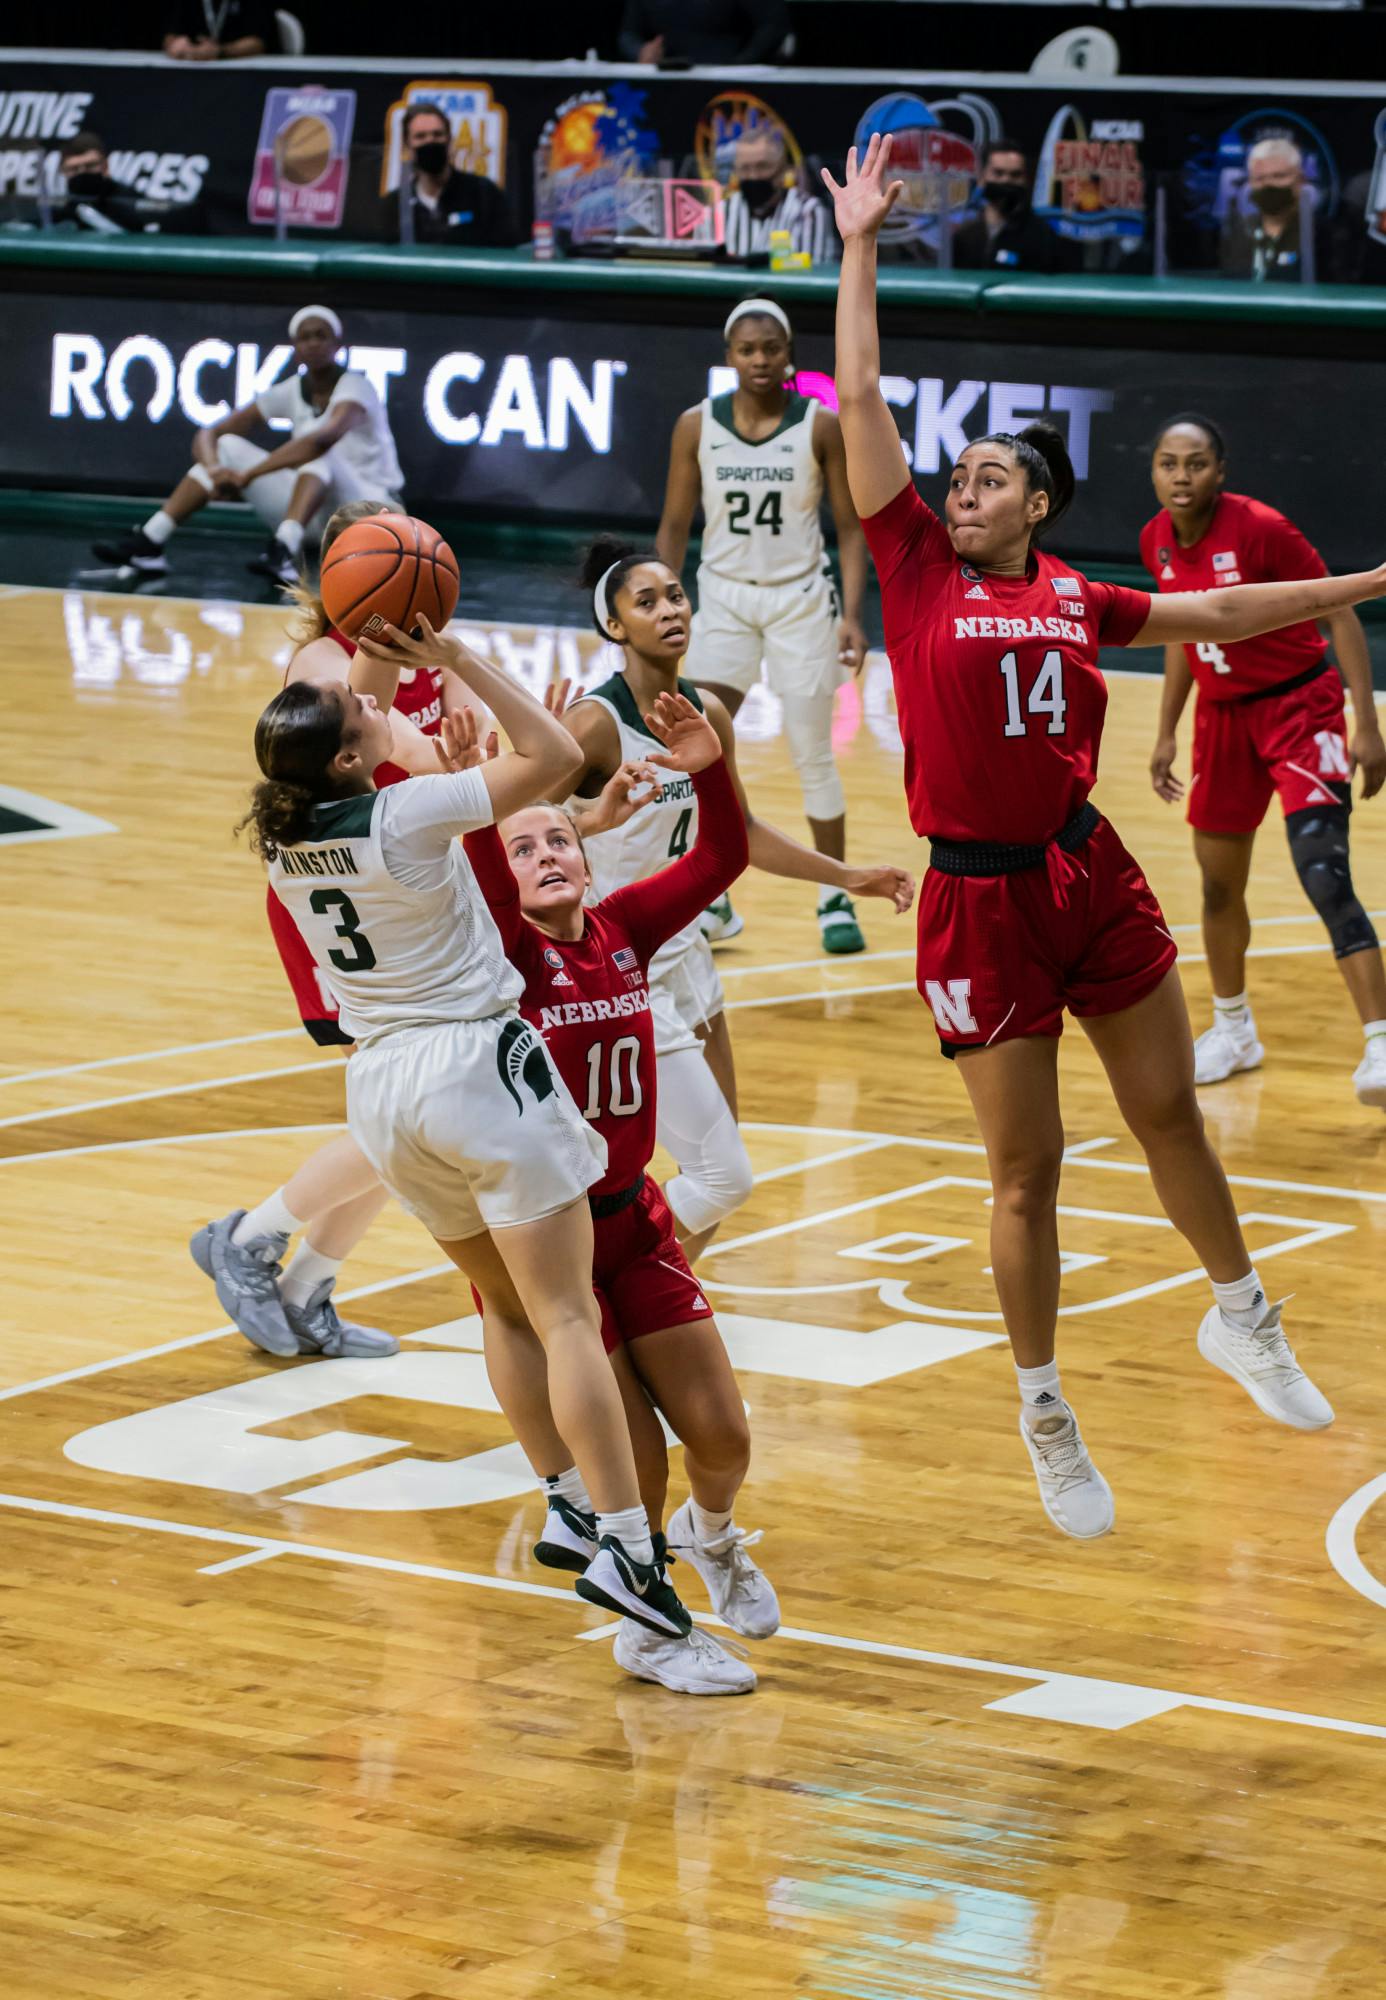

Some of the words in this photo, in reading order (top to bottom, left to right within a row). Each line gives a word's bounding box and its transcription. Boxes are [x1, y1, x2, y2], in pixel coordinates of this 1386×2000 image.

[50, 333, 407, 431] ROCKT
[716, 466, 794, 482] SPARTANS
[725, 491, 783, 535] 24
[954, 616, 1088, 646] NEBRASKA
[1000, 650, 1067, 737] 14
[667, 808, 692, 858] 4
[277, 847, 359, 875] WINSTON
[309, 888, 377, 972] 3
[925, 979, 979, 1034] N
[583, 1035, 643, 1119] 10
